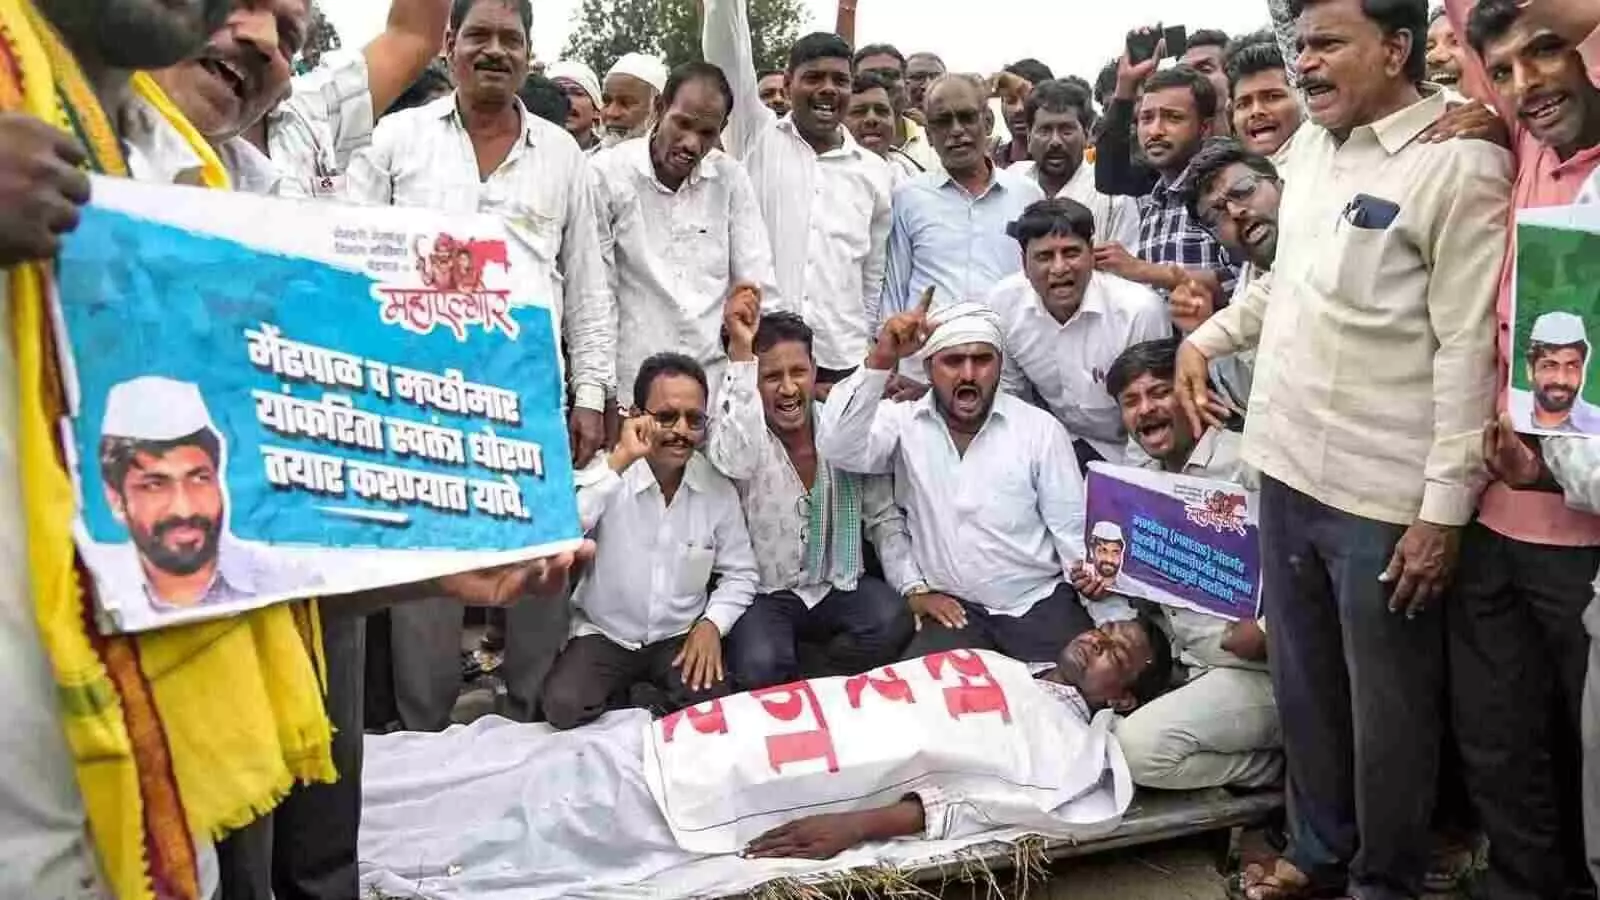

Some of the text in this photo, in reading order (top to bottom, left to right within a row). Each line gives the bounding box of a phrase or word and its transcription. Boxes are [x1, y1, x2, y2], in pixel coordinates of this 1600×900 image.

[379, 288, 514, 336] महाएल्गार
[244, 321, 520, 424] मेंढपाळ व मच्छीमार
[252, 384, 544, 476] यांकरिता स्वतंत्र धोरण
[258, 445, 532, 519] तयार करण्यात यावे.
